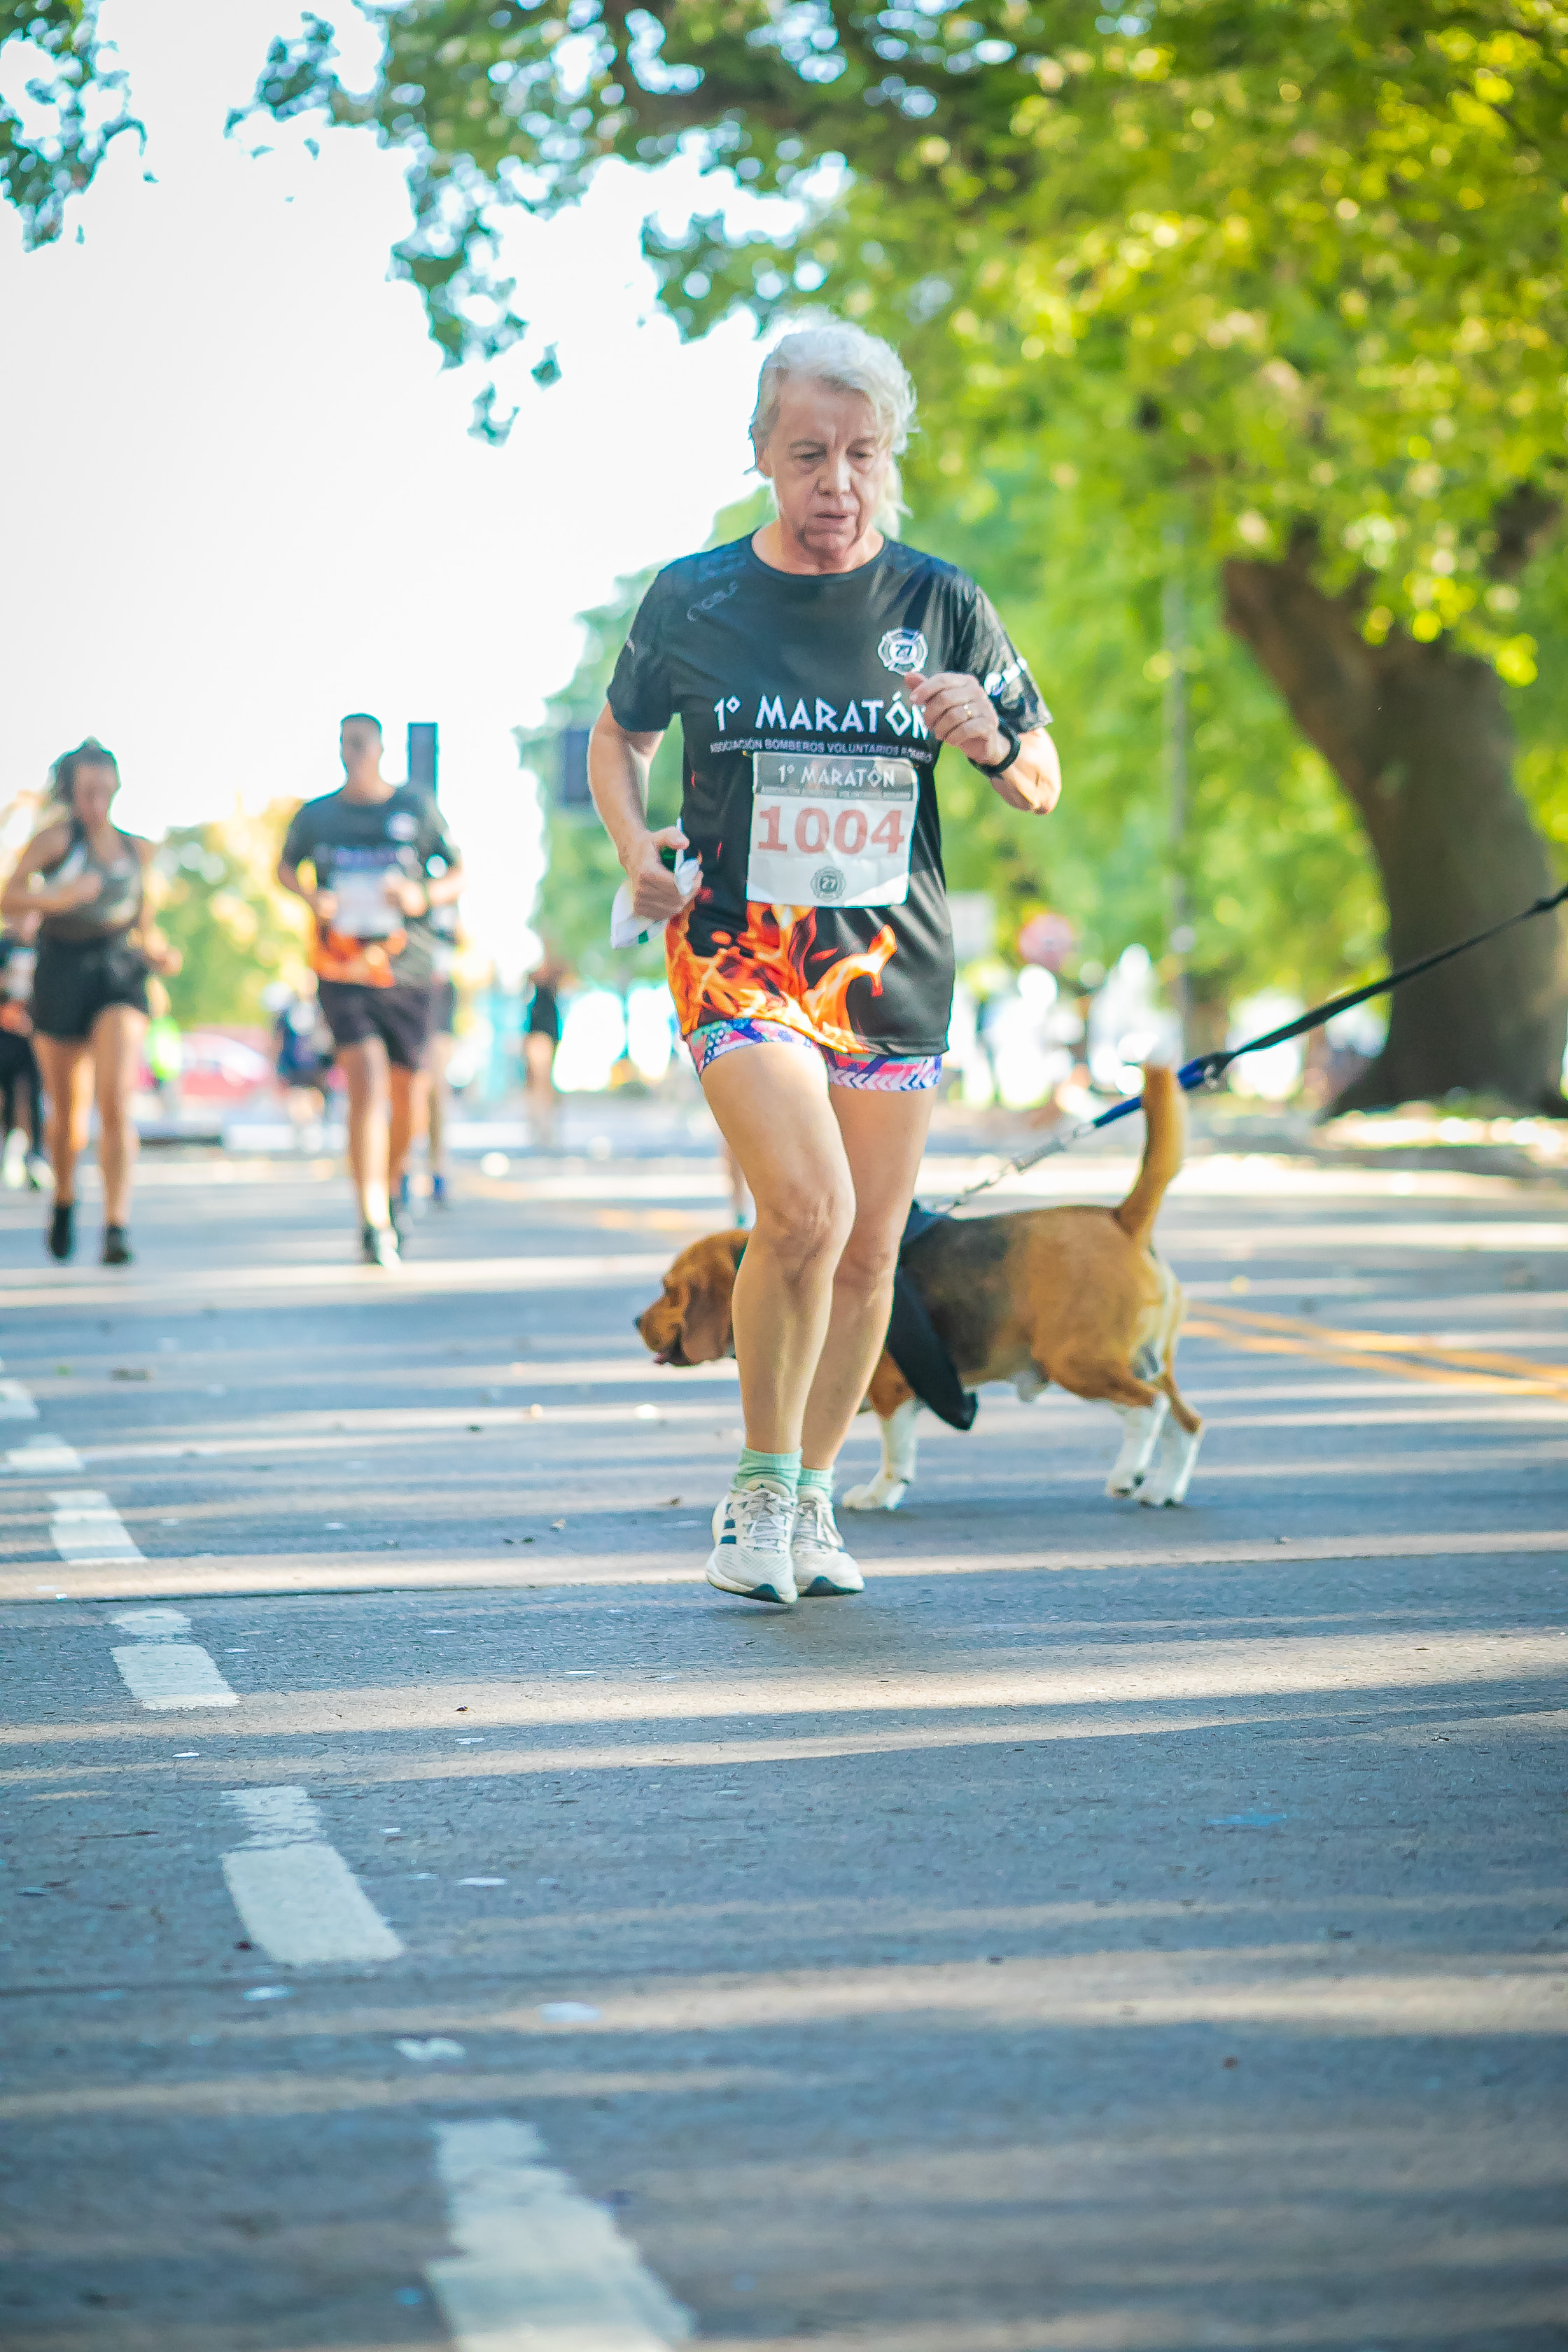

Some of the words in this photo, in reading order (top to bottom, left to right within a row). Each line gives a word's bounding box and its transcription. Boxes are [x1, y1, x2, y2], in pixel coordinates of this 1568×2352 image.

[764, 738, 825, 752] BOMBEROS
[827, 743, 899, 755] VOLUNTARIOS
[800, 762, 896, 788] MARATÓN
[757, 806, 905, 855] 1004
